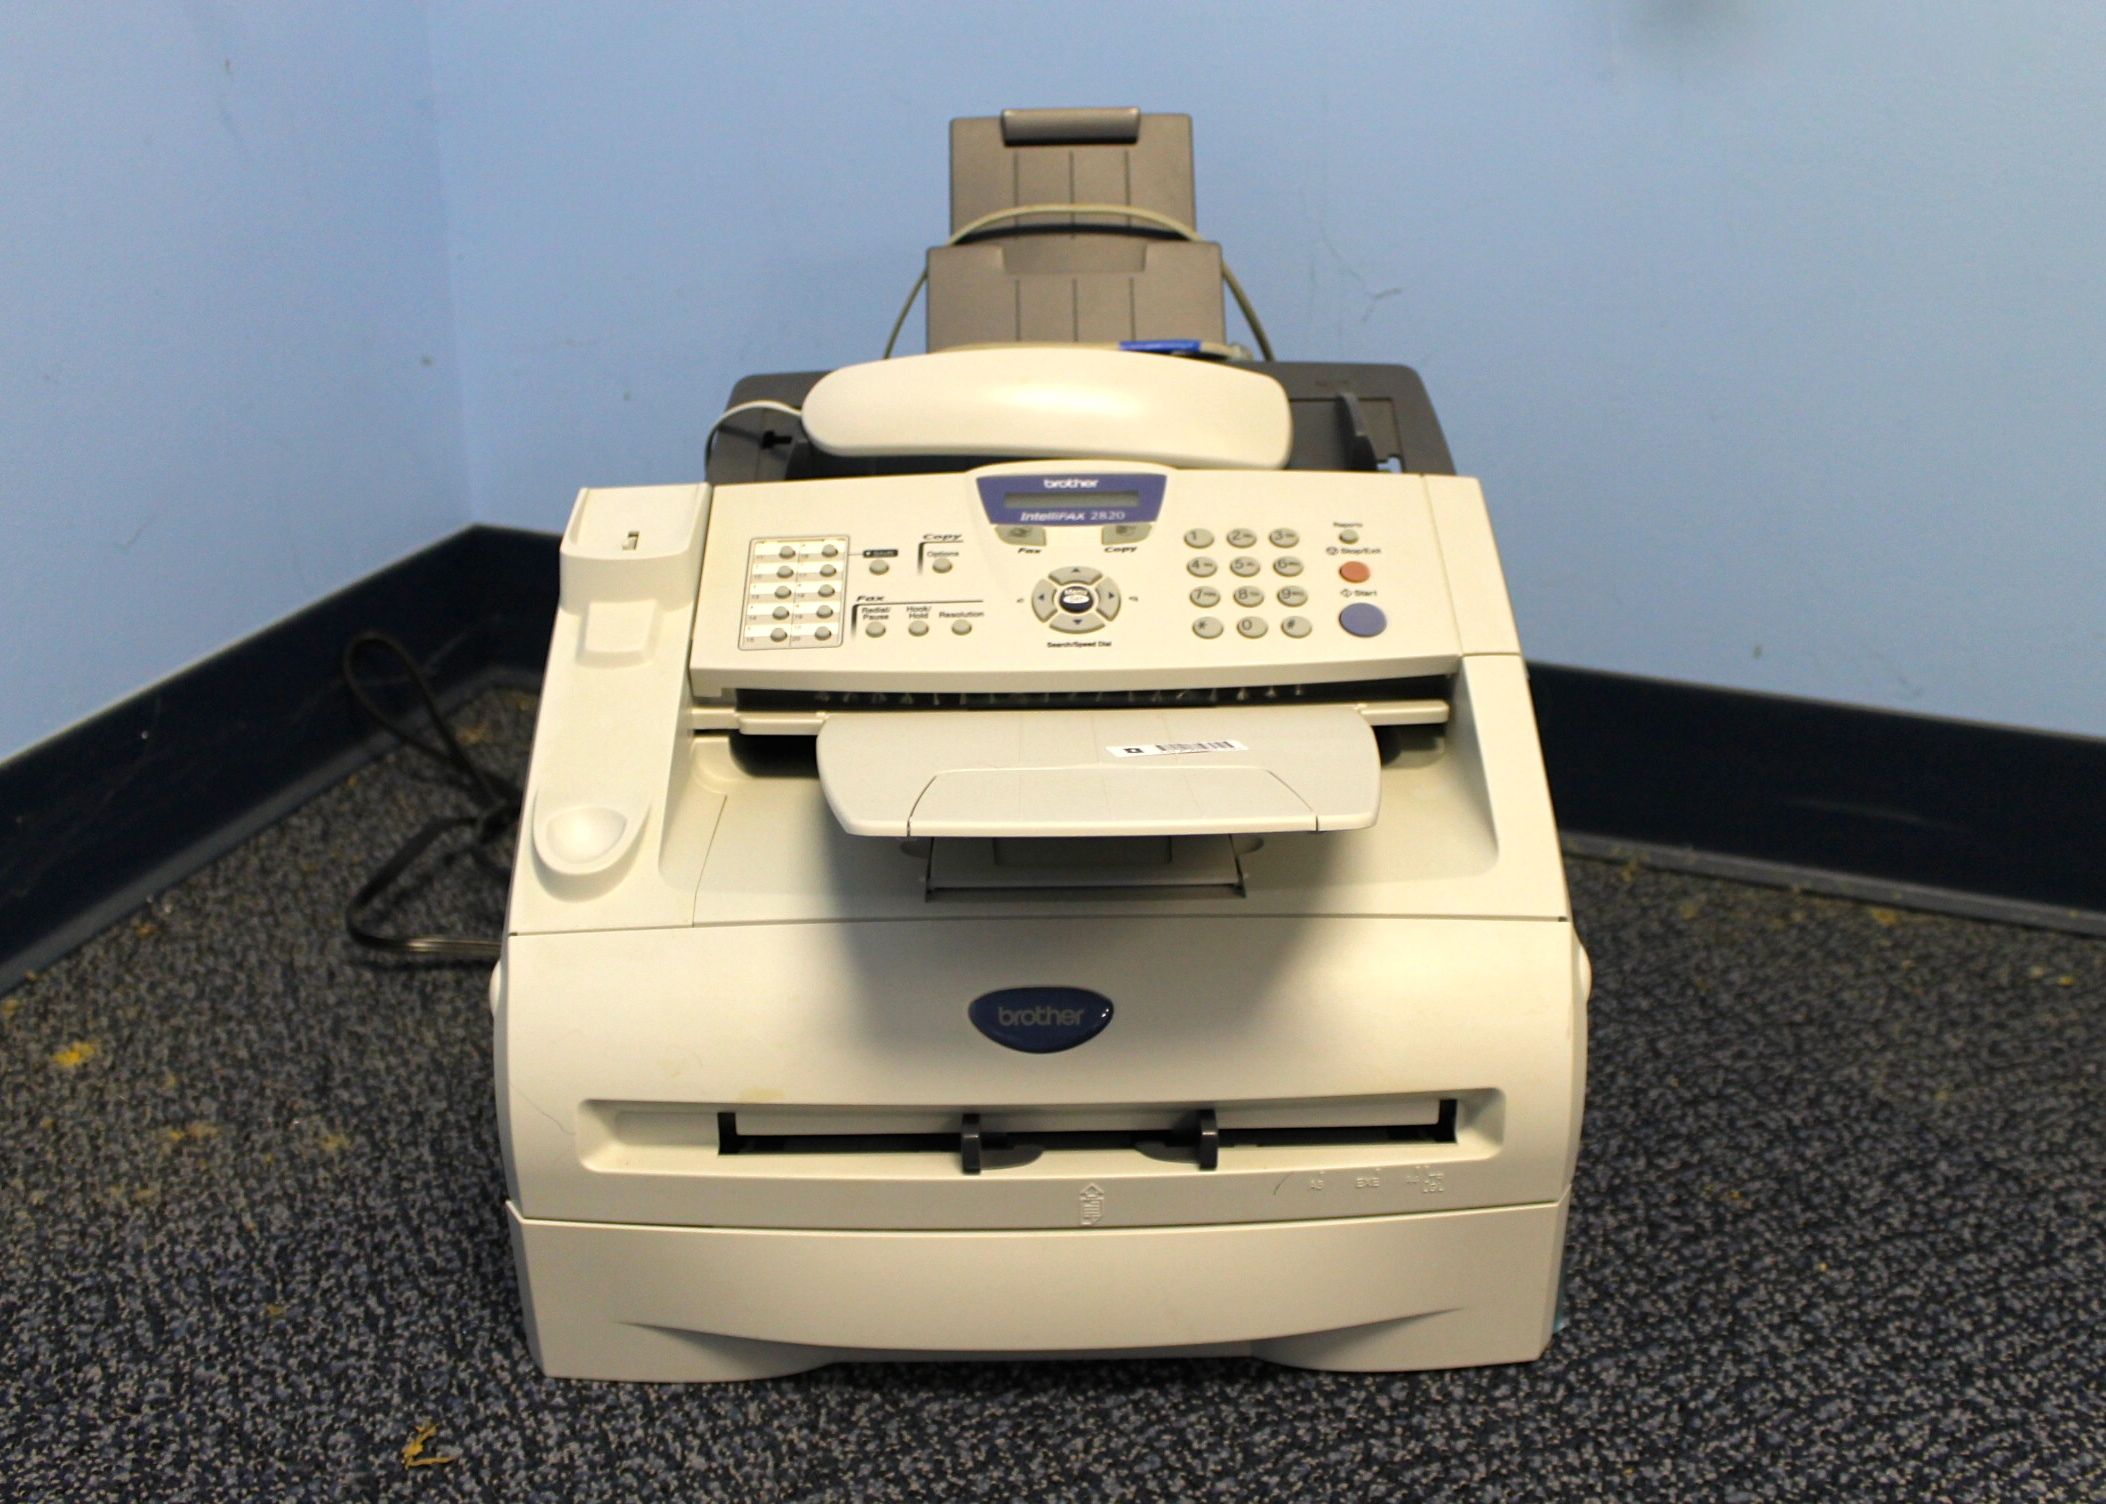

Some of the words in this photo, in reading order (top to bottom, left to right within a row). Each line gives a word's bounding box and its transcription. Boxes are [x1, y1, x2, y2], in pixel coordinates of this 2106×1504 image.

[1043, 478, 1099, 489] brother
[1020, 511, 1085, 522] IntelliFAX
[1089, 511, 1126, 521] 2820
[923, 533, 962, 541] Copy
[1231, 530, 1241, 541] 2
[1274, 530, 1284, 541] 3
[1191, 560, 1201, 569] 4
[1234, 559, 1245, 570] 5
[1277, 559, 1288, 570] 6
[1238, 589, 1249, 600] 8
[1281, 588, 1292, 600] 9
[1354, 589, 1378, 597] Start
[997, 1006, 1085, 1026] brother
